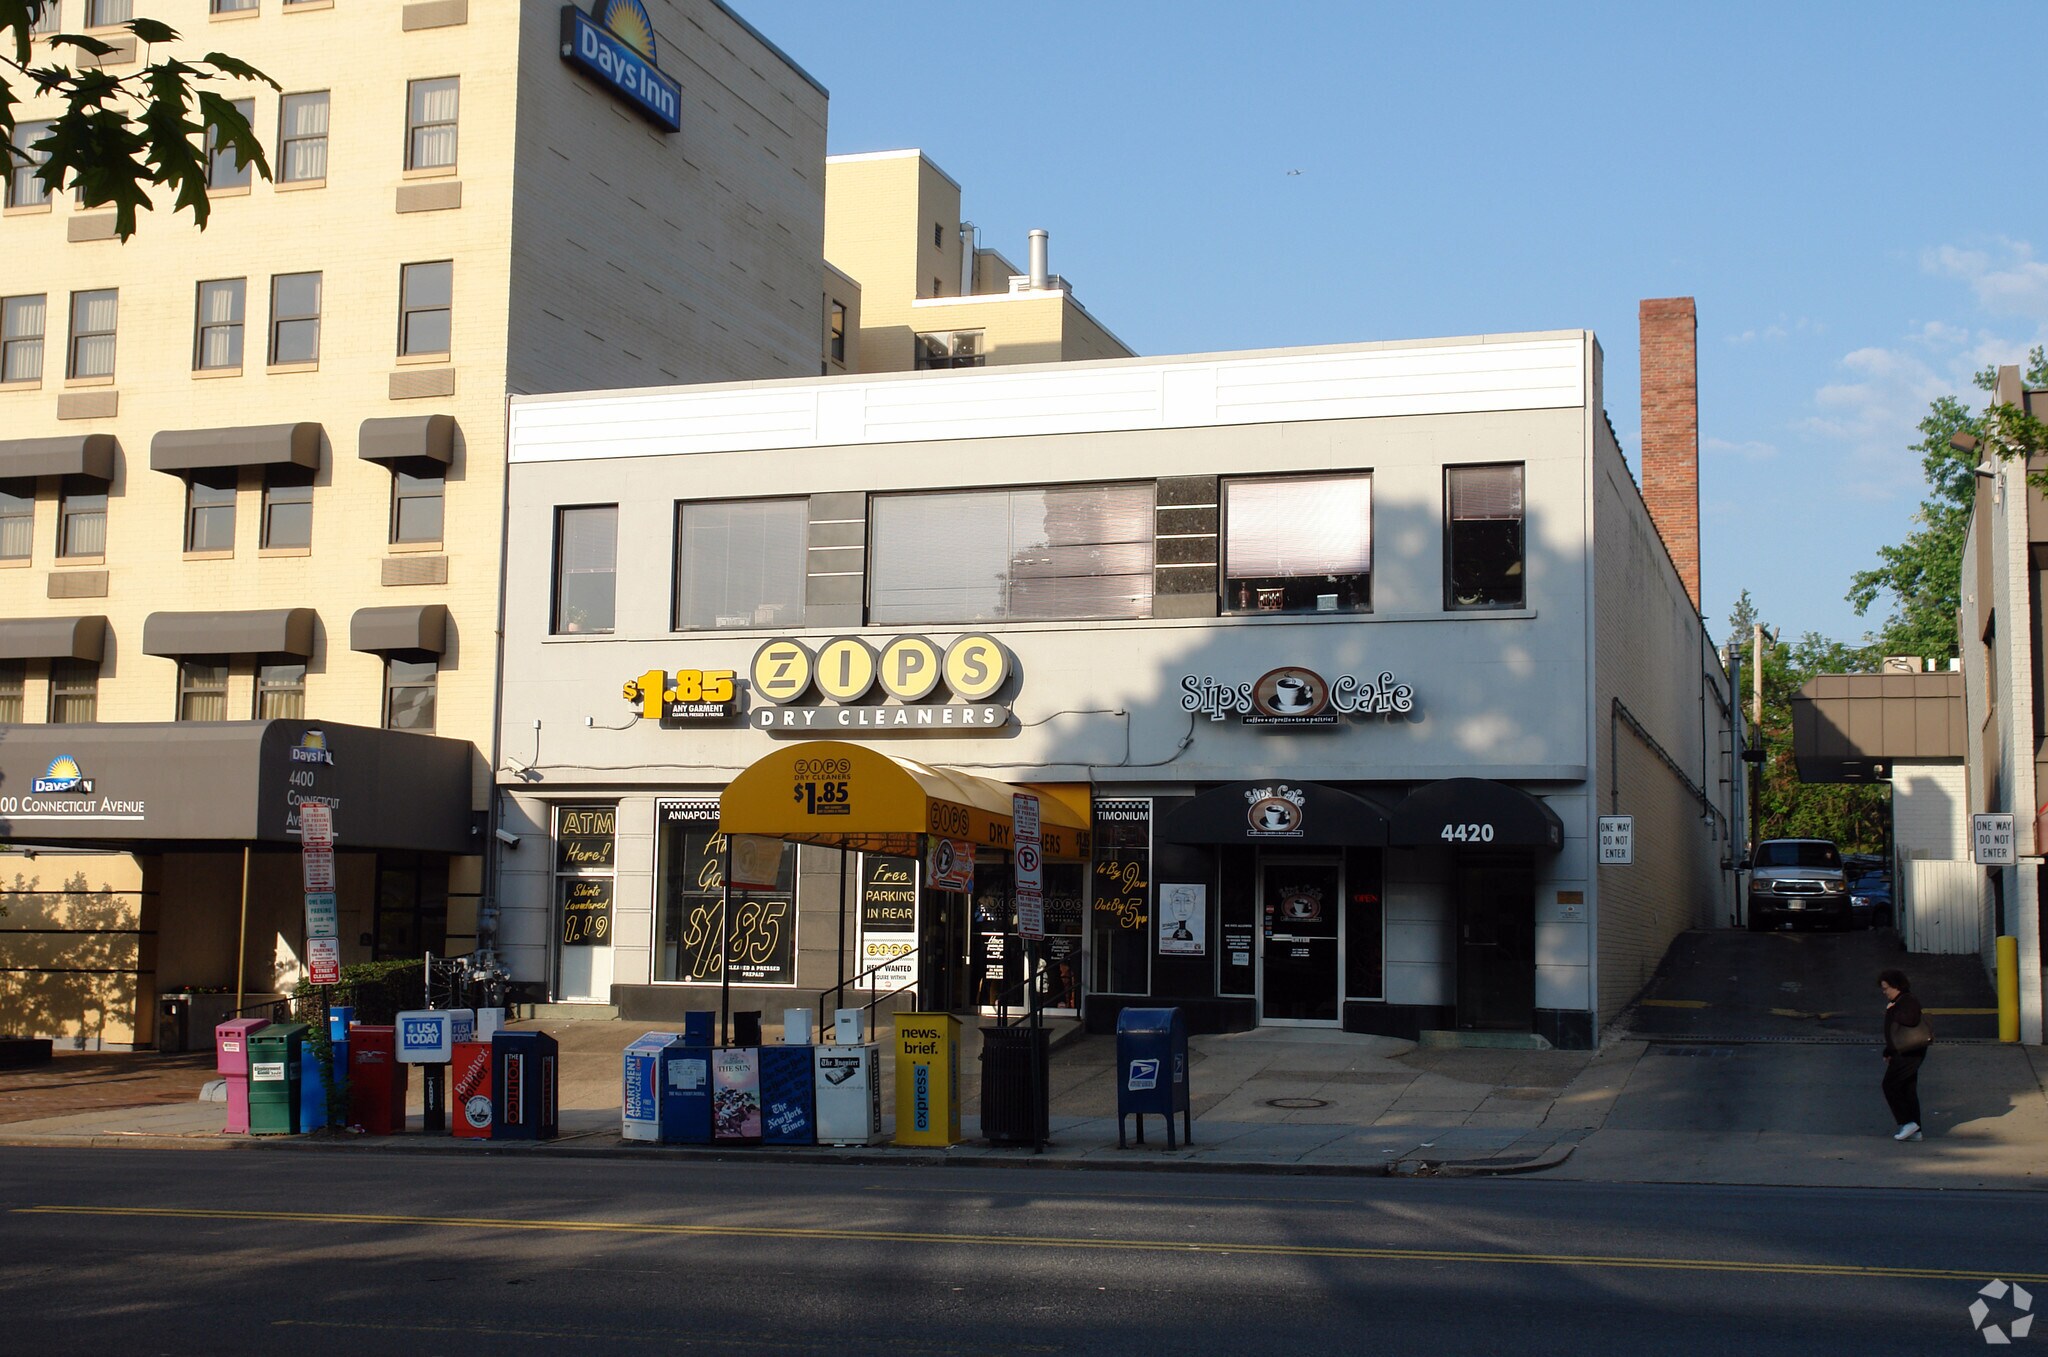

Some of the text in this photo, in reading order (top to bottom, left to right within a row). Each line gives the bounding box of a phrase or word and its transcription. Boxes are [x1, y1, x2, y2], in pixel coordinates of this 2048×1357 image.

[582, 23, 674, 118] Days Inn
[764, 642, 993, 695] ZIPS
[623, 670, 735, 718] $1.85
[1180, 670, 1413, 721] Sips Cafe
[761, 708, 996, 726] DRY CLEANERS
[293, 748, 316, 762] Days
[796, 760, 849, 773] ZIPS
[289, 770, 314, 787] 4400
[22, 797, 96, 812] CONNECTICUT
[100, 796, 144, 812] AVENUE
[794, 782, 848, 814] $1.85
[563, 812, 615, 835] ATM
[668, 811, 720, 820] ANNAPOLIS
[1097, 811, 1148, 820] TIMONIUM
[932, 804, 968, 834] ZIPS
[990, 822, 1010, 845] DRY
[1601, 823, 1630, 832] ONE WAY
[1977, 821, 2011, 830] ONE WAY
[1441, 824, 1494, 842] 4420
[1603, 836, 1628, 845] DO NOT
[1980, 835, 2009, 844] DO NOT
[566, 842, 611, 863] Here!
[1606, 849, 1626, 858] ENTER
[1983, 848, 2007, 858] ENTER
[874, 864, 908, 881] Free
[1107, 862, 1121, 880] By
[574, 884, 601, 897] Shirts
[866, 890, 915, 902] PARKING
[867, 908, 913, 919] IN REAR
[1111, 898, 1125, 915] By
[564, 915, 608, 943] 1.19
[885, 964, 912, 972] WANTED
[417, 1023, 438, 1033] USA
[902, 1028, 941, 1039] news.
[406, 1033, 439, 1044] TODAY
[904, 1042, 938, 1054] brief.
[455, 1048, 490, 1094] Brighter.
[508, 1060, 518, 1123] POLITICO
[627, 1057, 636, 1117] APARTMENT
[917, 1068, 928, 1128] express
[771, 1102, 787, 1114] The
[768, 1107, 802, 1130] New York
[781, 1119, 805, 1134] Times
